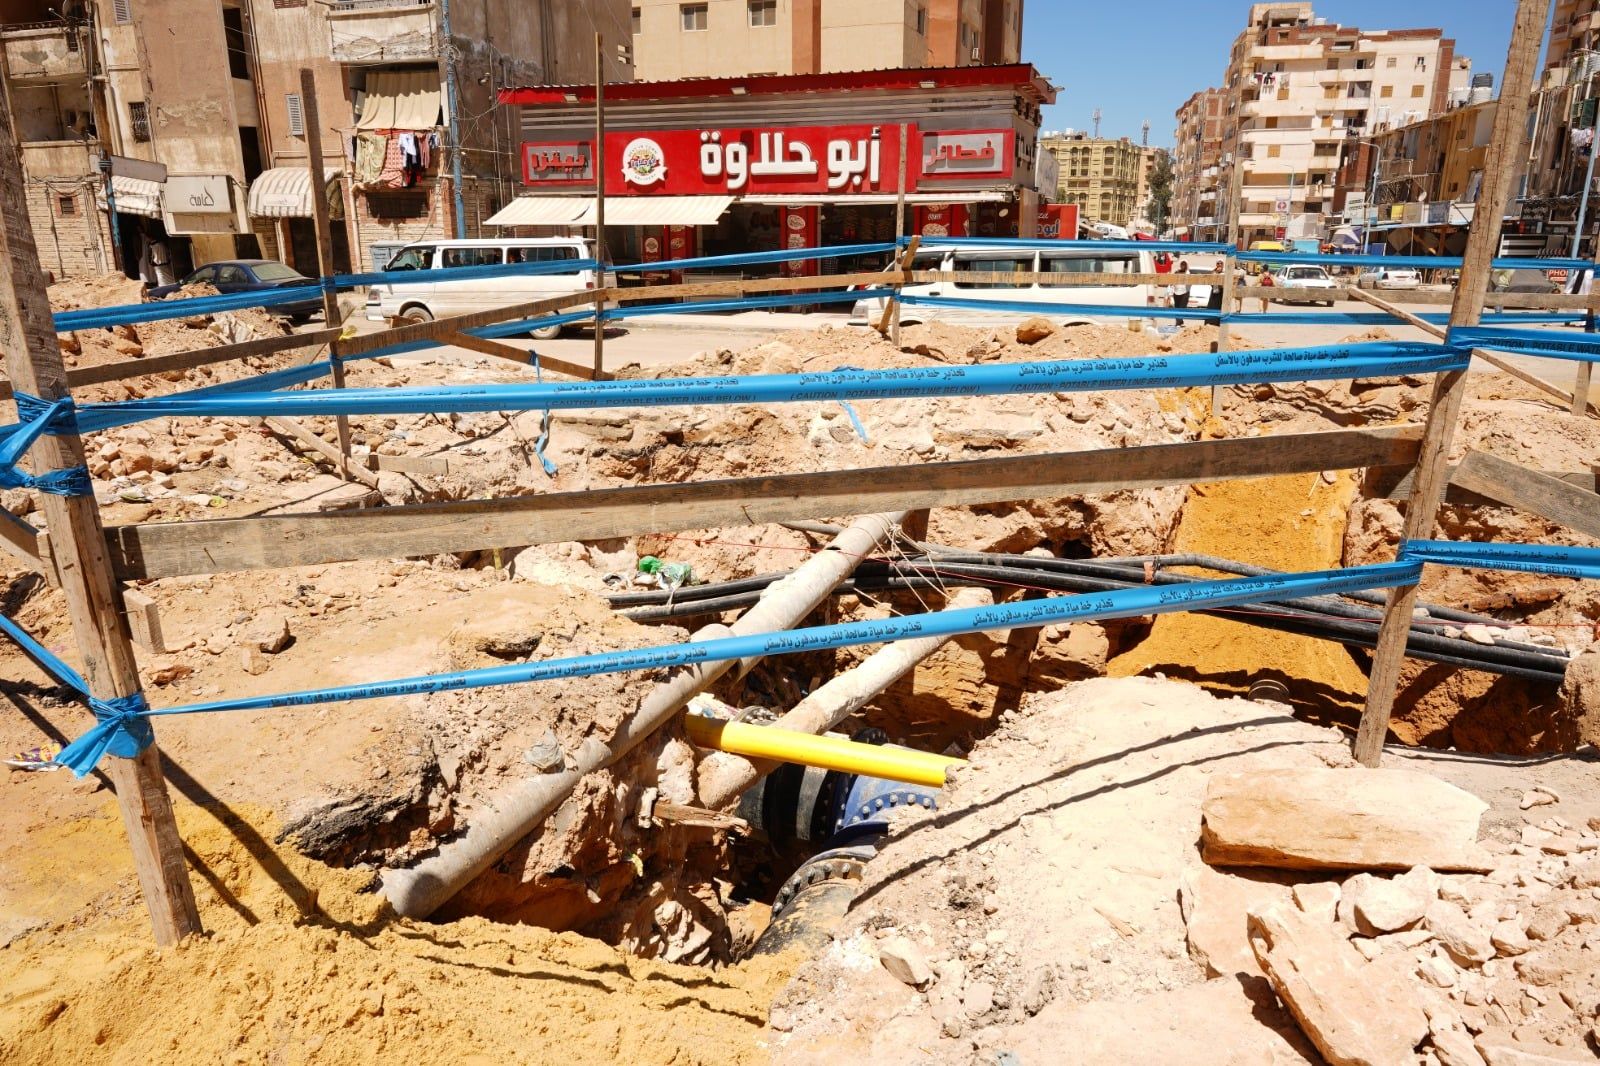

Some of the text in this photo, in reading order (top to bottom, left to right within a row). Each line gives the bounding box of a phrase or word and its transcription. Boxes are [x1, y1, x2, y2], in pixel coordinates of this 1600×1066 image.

[531, 150, 585, 172] بيتزا
[700, 126, 881, 189] أبو حلاوة
[926, 139, 995, 166] فطائر
[889, 387, 920, 396] WATER
[920, 386, 942, 394] LINE
[606, 397, 652, 405] POTABLE
[1493, 560, 1522, 571] WATER
[1524, 563, 1543, 572] LINE
